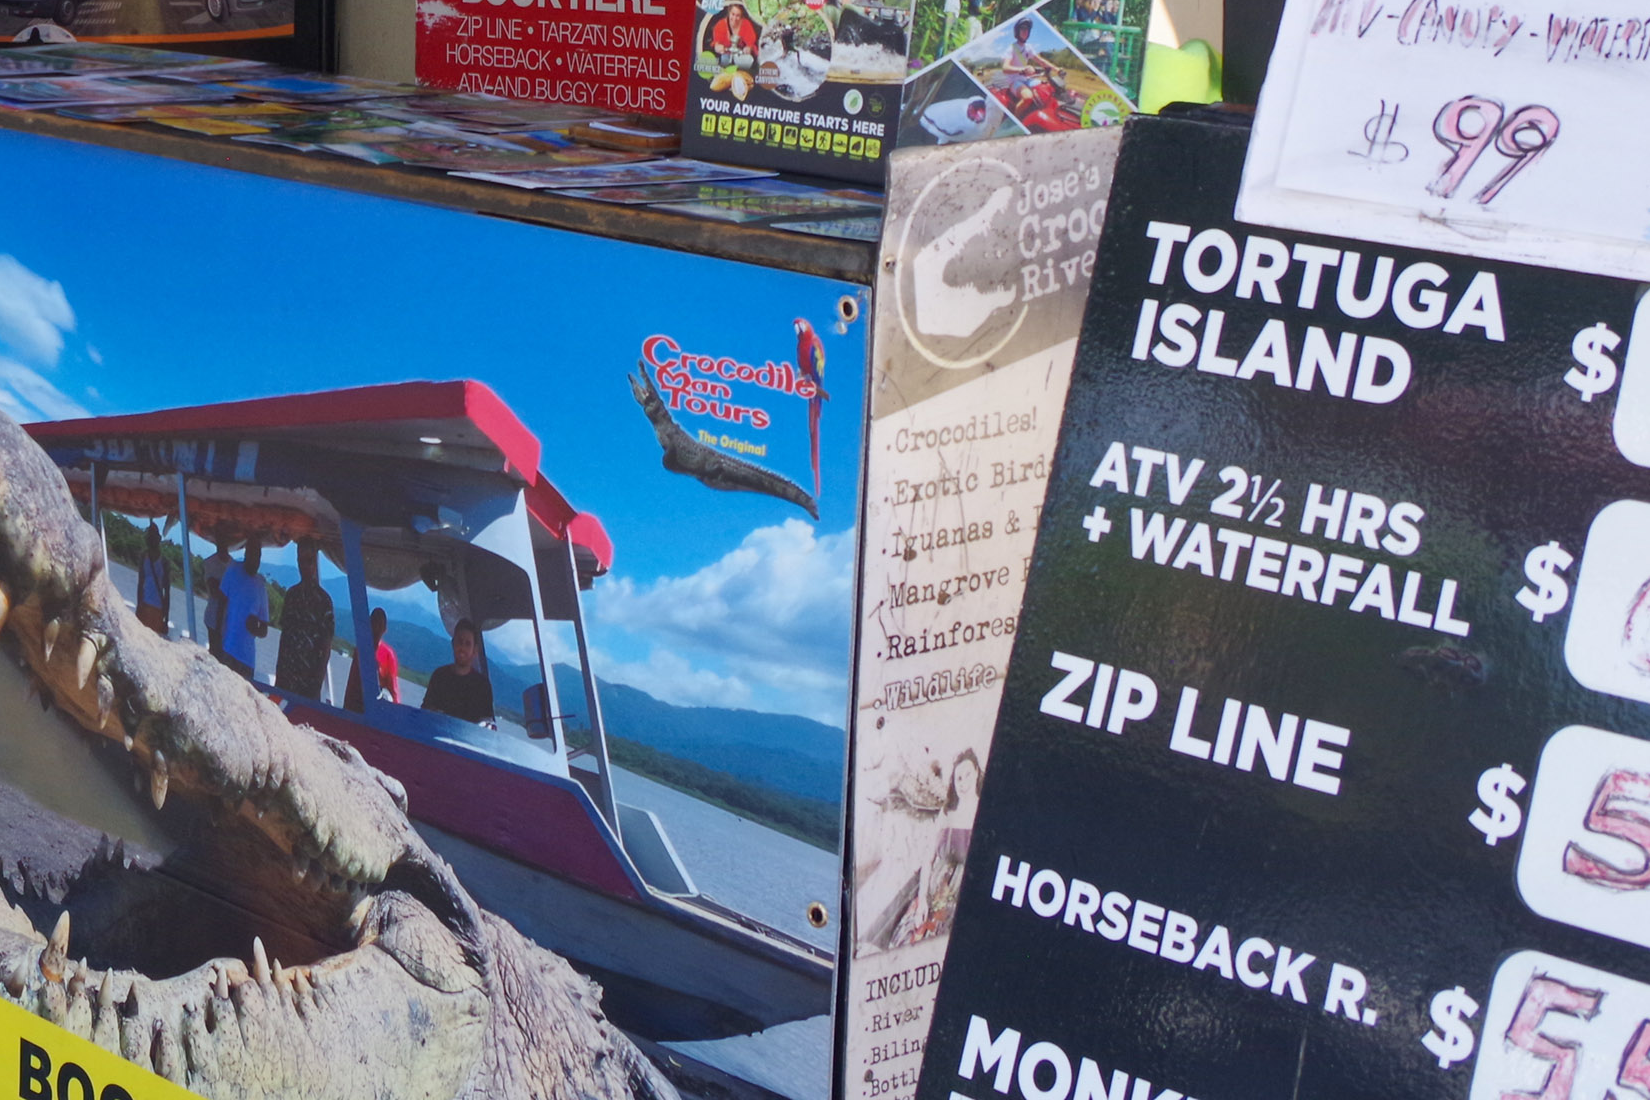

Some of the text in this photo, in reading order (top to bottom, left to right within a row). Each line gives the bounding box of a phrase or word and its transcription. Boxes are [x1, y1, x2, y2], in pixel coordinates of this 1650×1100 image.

[456, 15, 674, 50] ZIP LINE TARZAN SWING
[446, 44, 680, 82] HORSEBACK WATERFALLS
[536, 78, 666, 110] BUGGY TOURS
[700, 98, 885, 137] YOUR ADVENTURE STARTS HERE
[1425, 94, 1561, 205] 99
[1019, 200, 1107, 259] Croc
[1146, 220, 1506, 343] TORTUGA
[1130, 298, 1413, 405] ISLAND
[720, 435, 766, 456] Original
[1089, 442, 1427, 557] ATV HRS
[1129, 507, 1471, 637] WATERFALL
[886, 616, 1015, 661] Rainfores
[884, 663, 998, 712] Wildlife
[1039, 651, 1351, 796] ZIP LINE
[991, 854, 1317, 1004] HORSEBACK
[866, 962, 941, 1003] INCLUD
[872, 1006, 923, 1033] River
